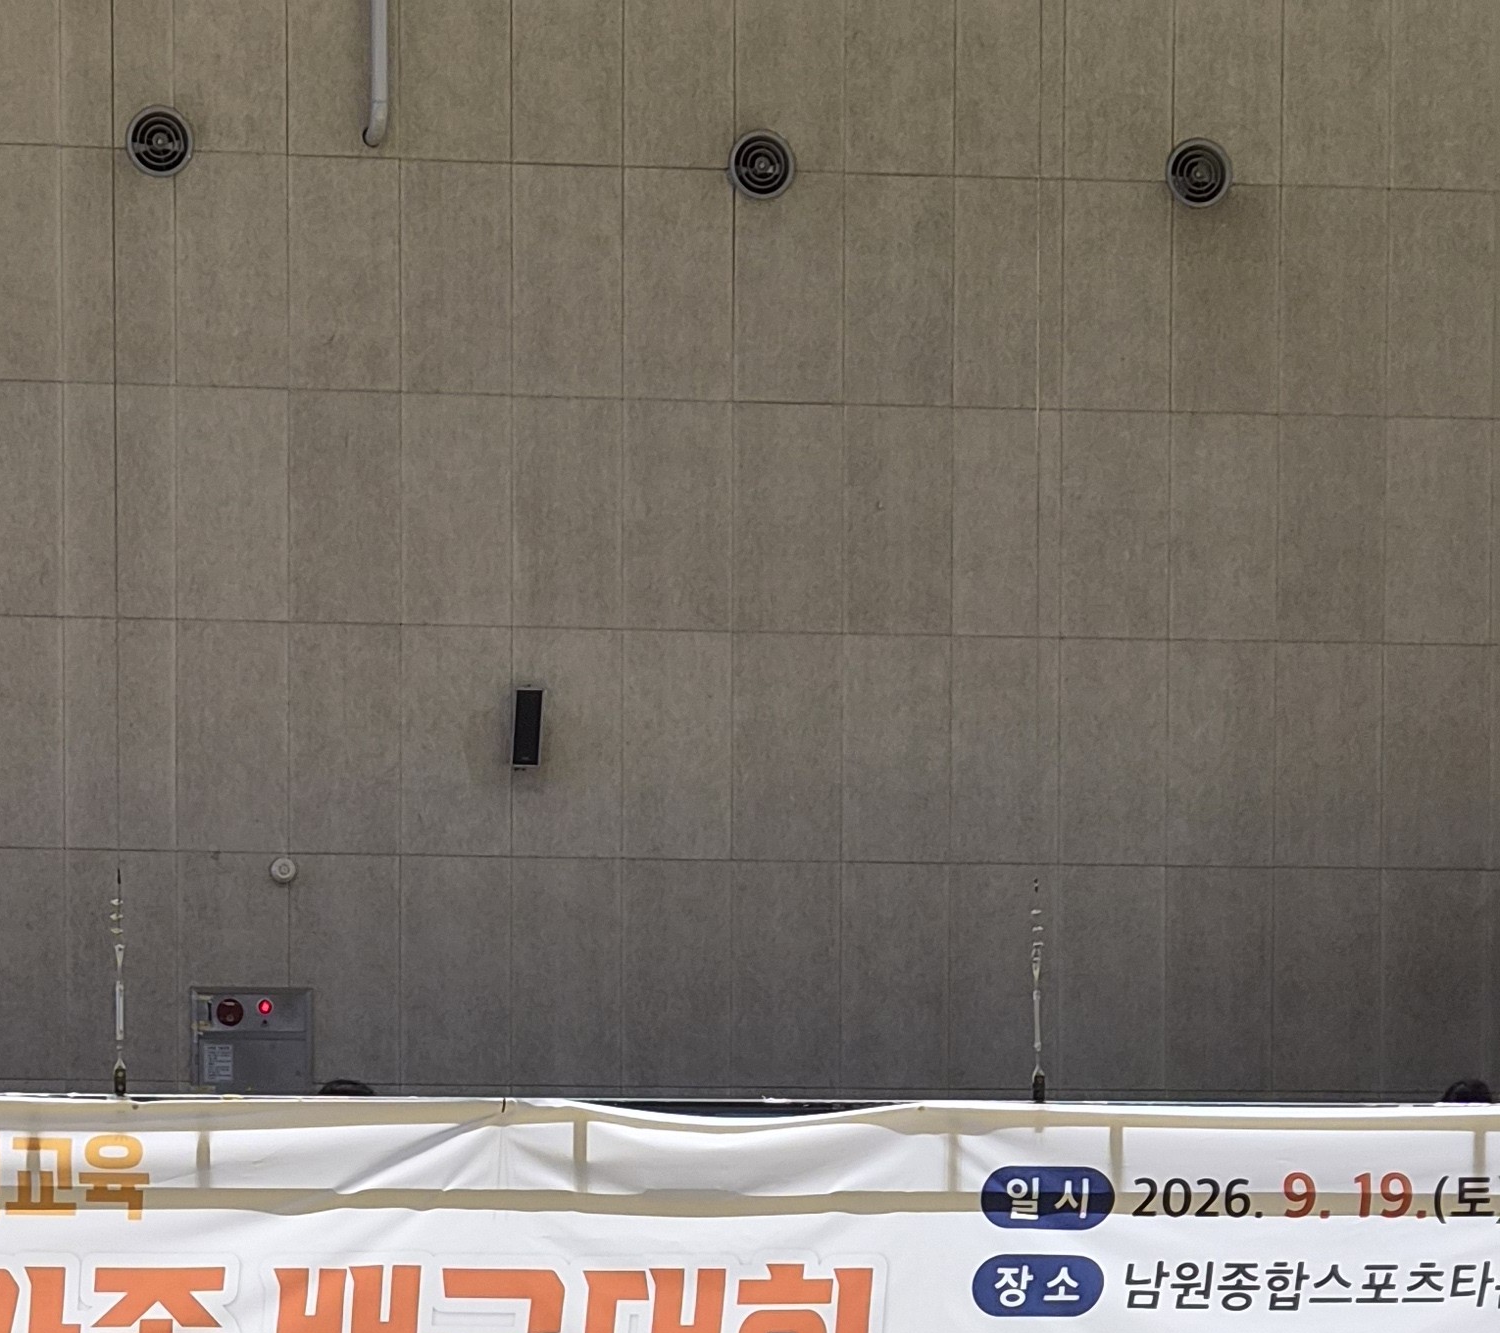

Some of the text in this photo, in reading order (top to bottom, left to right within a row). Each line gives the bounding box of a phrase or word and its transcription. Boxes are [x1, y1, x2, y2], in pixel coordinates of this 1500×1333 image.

[1132, 1176, 1263, 1218] 2026.
[1283, 1172, 1331, 1219] 9.
[1124, 1260, 1500, 1312] 남원종합스포츠타
